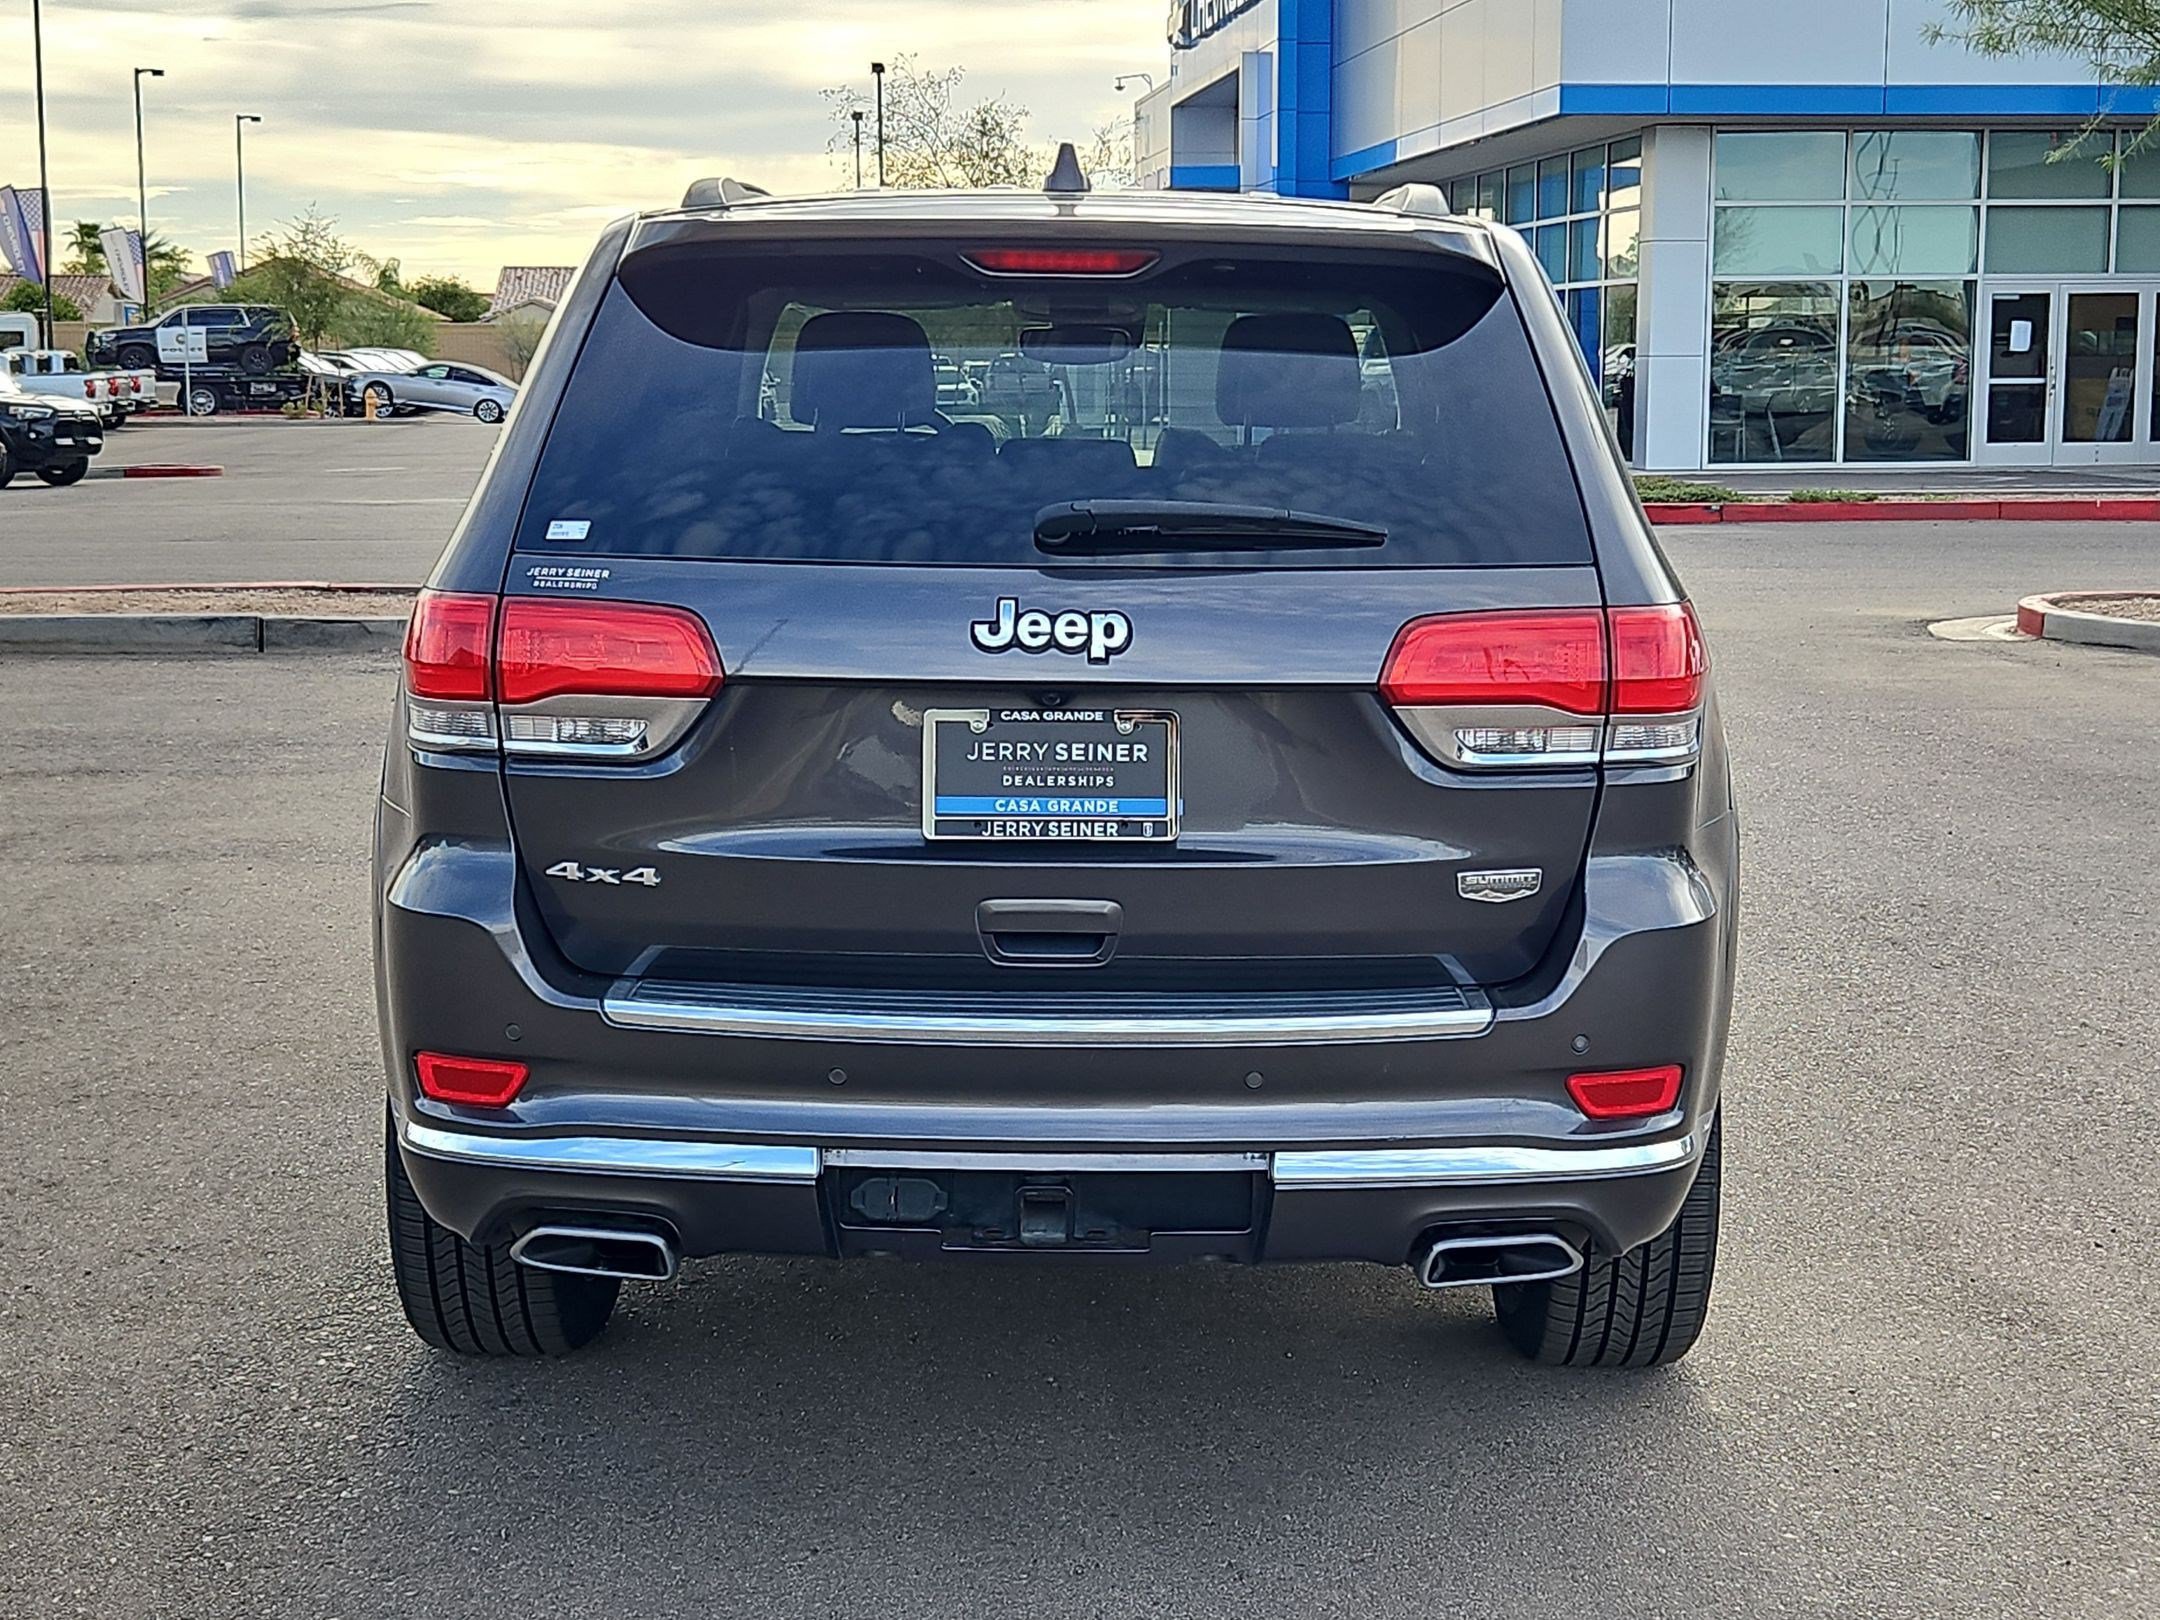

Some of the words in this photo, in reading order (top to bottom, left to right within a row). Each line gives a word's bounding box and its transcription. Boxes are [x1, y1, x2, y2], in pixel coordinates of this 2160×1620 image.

[526, 566, 566, 577] JERRY
[566, 567, 610, 579] SEINER
[972, 597, 1132, 664] Jeep
[1000, 710, 1041, 722] CASA
[1042, 710, 1104, 722] GRANDE
[966, 741, 1049, 761] JERRY
[1055, 742, 1148, 762] SEINER
[1002, 774, 1115, 787] DEALERSHIPS
[994, 799, 1040, 813] CASA
[1047, 800, 1119, 813] GRANDE
[981, 821, 1044, 837] JERRY
[1048, 821, 1119, 837] SEINER
[545, 861, 661, 886] 4x4
[1465, 873, 1537, 885] SUMMIT
